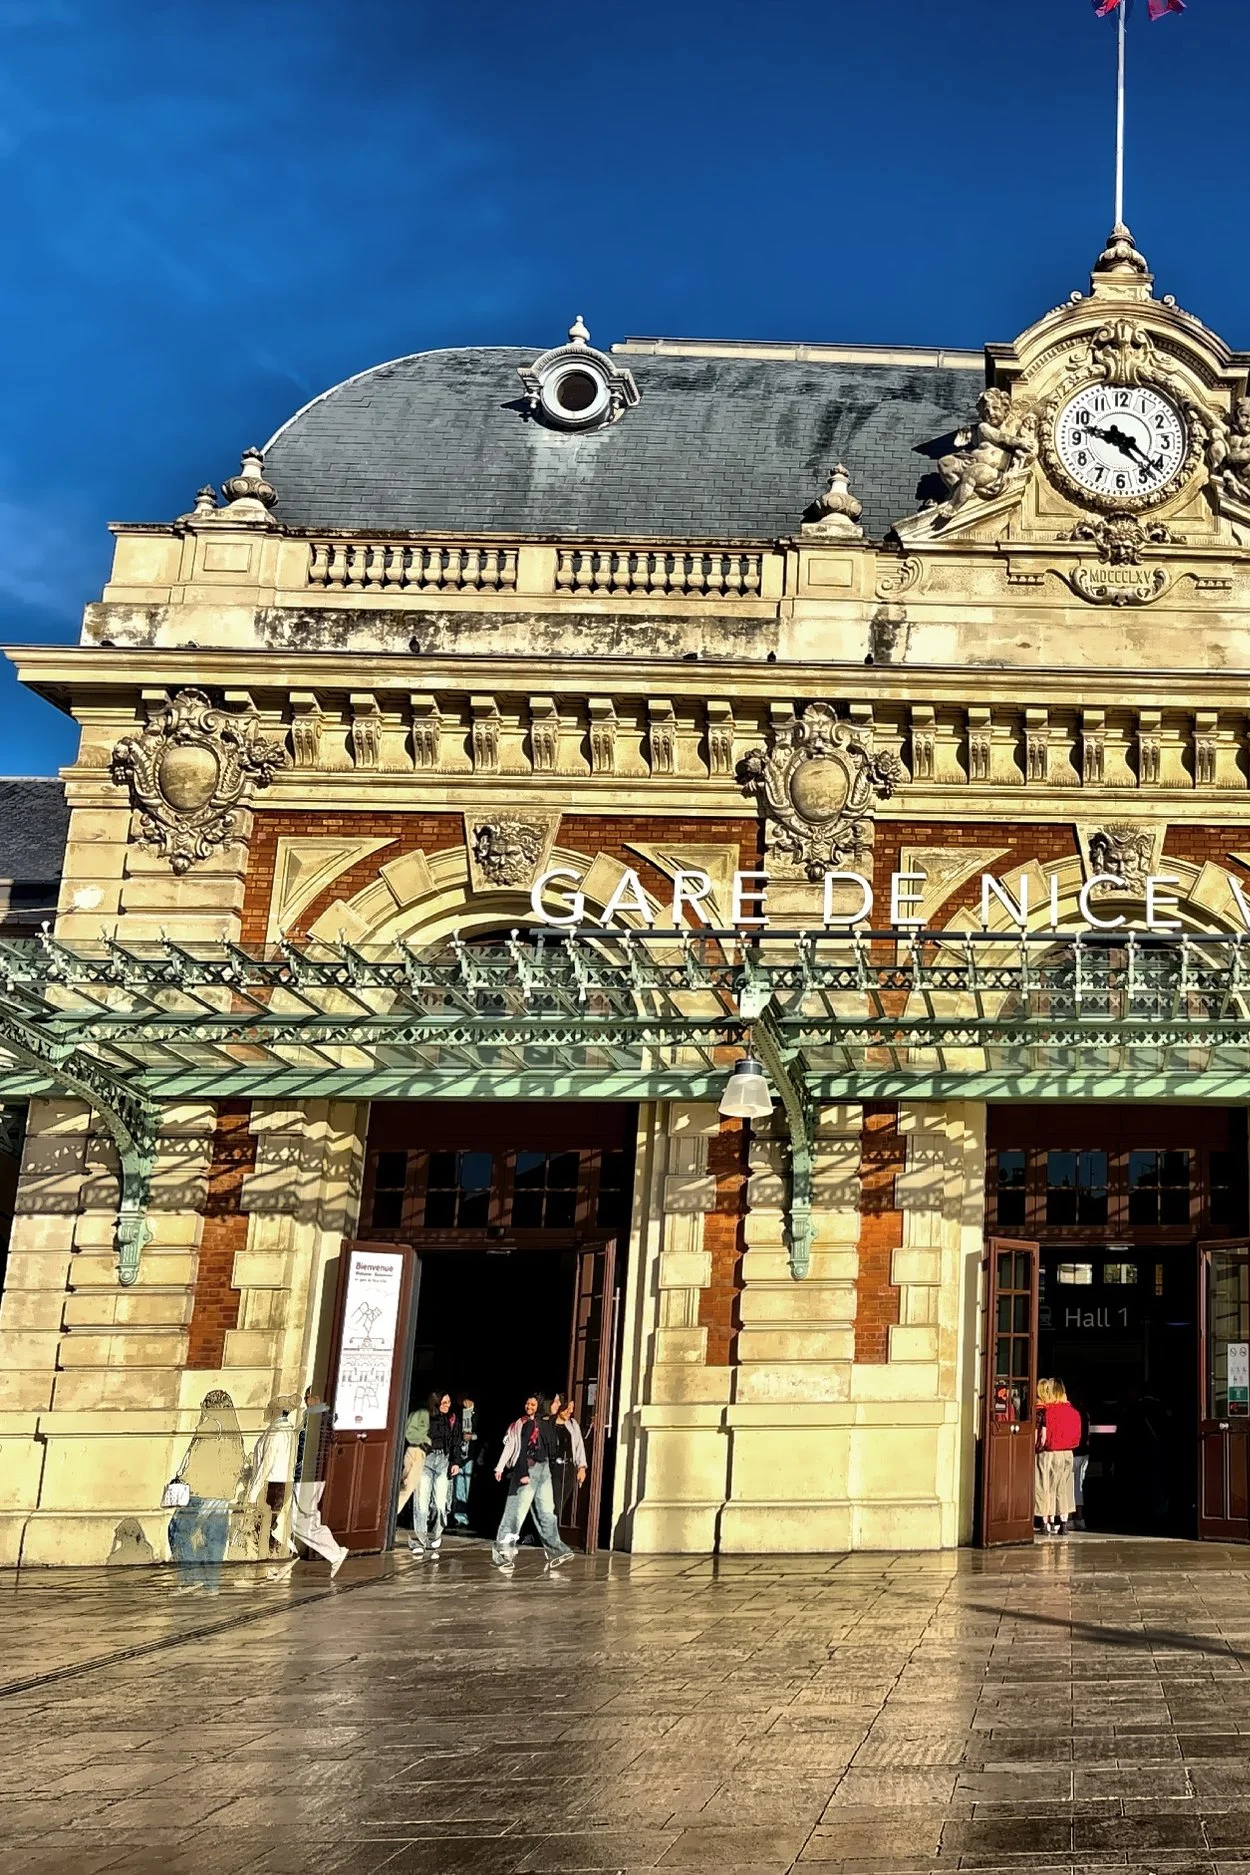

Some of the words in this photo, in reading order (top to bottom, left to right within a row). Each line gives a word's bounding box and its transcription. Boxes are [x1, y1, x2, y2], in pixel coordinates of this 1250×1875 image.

[1094, 397, 1105, 412] 11
[1114, 391, 1129, 408] 12
[1141, 399, 1146, 414] 1
[1075, 410, 1090, 425] 10
[1154, 414, 1165, 429] 2
[1072, 431, 1082, 446] 9
[1160, 434, 1170, 450] 3
[1077, 451, 1088, 467] 8
[1094, 467, 1104, 483] 7
[1115, 473, 1126, 489] 6
[1138, 468, 1148, 484] 5
[528, 867, 771, 926] GARE
[823, 870, 928, 927] DE
[981, 873, 1183, 930] NICE
[355, 1262, 394, 1272] Bienvenue
[1065, 1307, 1111, 1328] Hall
[1117, 1307, 1128, 1327] 1
